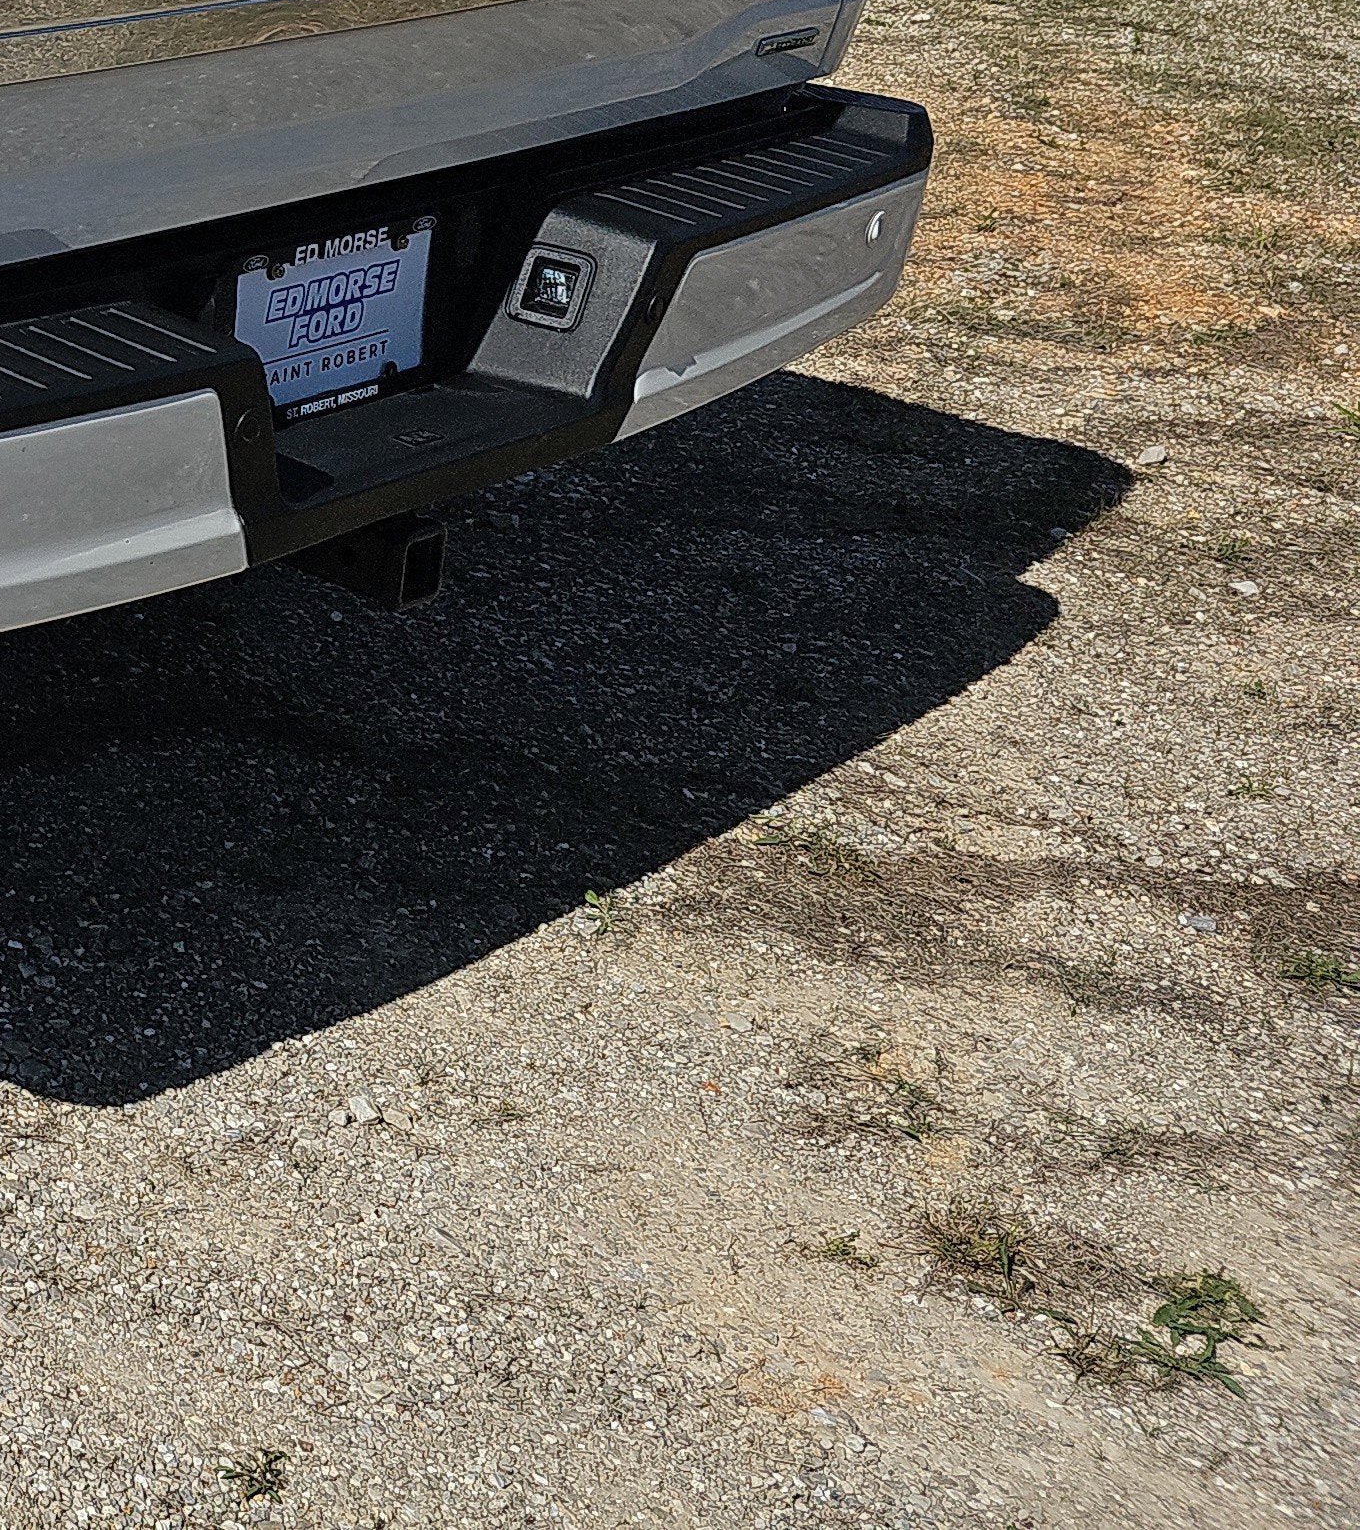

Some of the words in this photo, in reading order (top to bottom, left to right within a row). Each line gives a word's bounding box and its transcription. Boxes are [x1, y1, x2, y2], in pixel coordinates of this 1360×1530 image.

[295, 244, 319, 266] ED
[324, 227, 390, 260] MORSE
[265, 284, 305, 324] ED
[303, 258, 401, 313] MORSE
[288, 299, 365, 349] FORD
[269, 360, 313, 386] AINT
[321, 340, 389, 372] ROBERT
[300, 397, 337, 417] ROBERT,
[337, 384, 379, 406] MISSOURI
